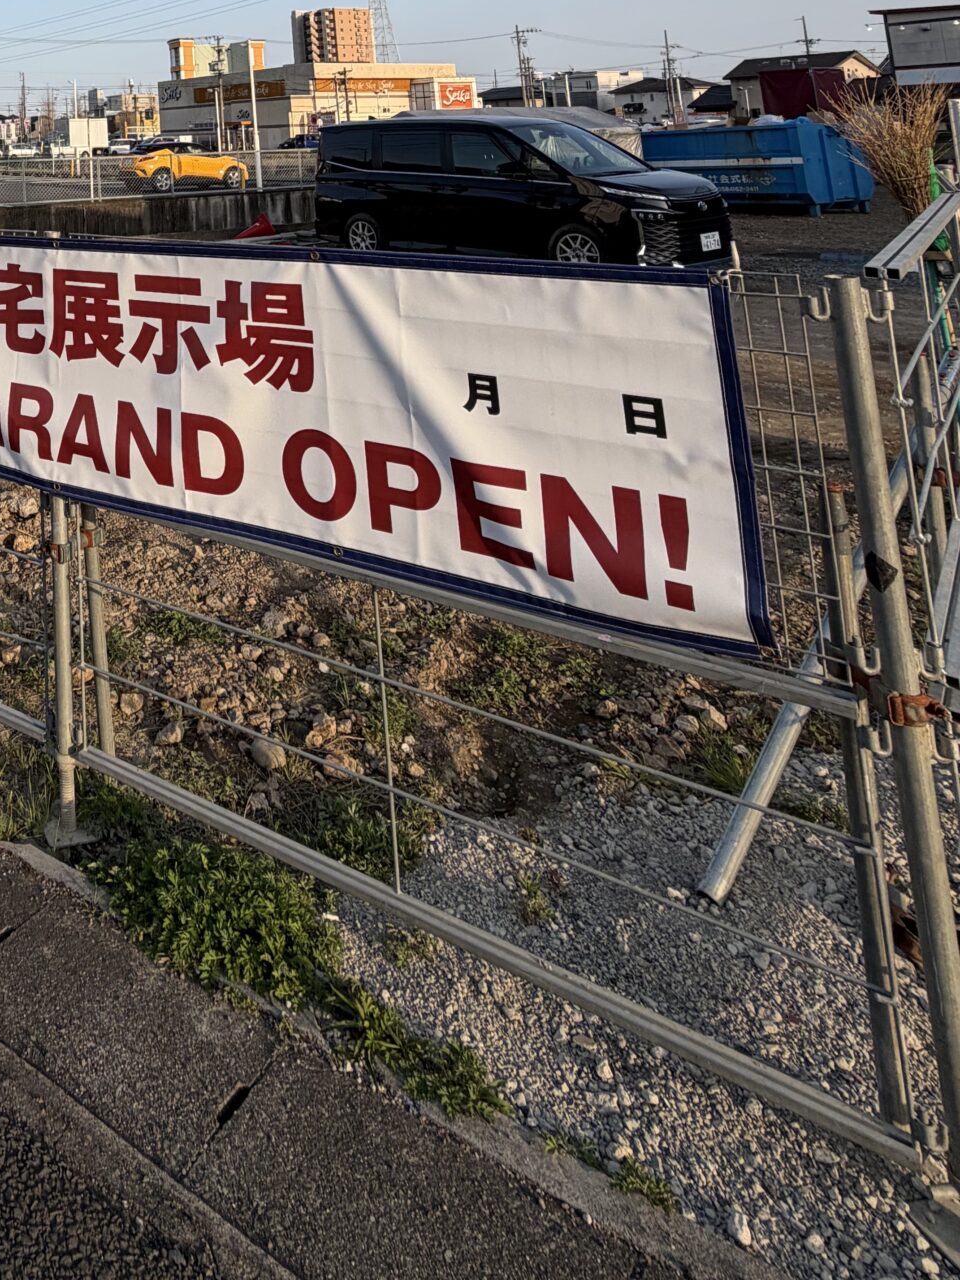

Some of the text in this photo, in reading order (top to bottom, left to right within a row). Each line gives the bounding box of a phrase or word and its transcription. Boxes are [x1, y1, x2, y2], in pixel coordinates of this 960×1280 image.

[443, 87, 471, 106] Seika
[462, 372, 667, 439] 月 日
[282, 428, 696, 613] OPEN!
